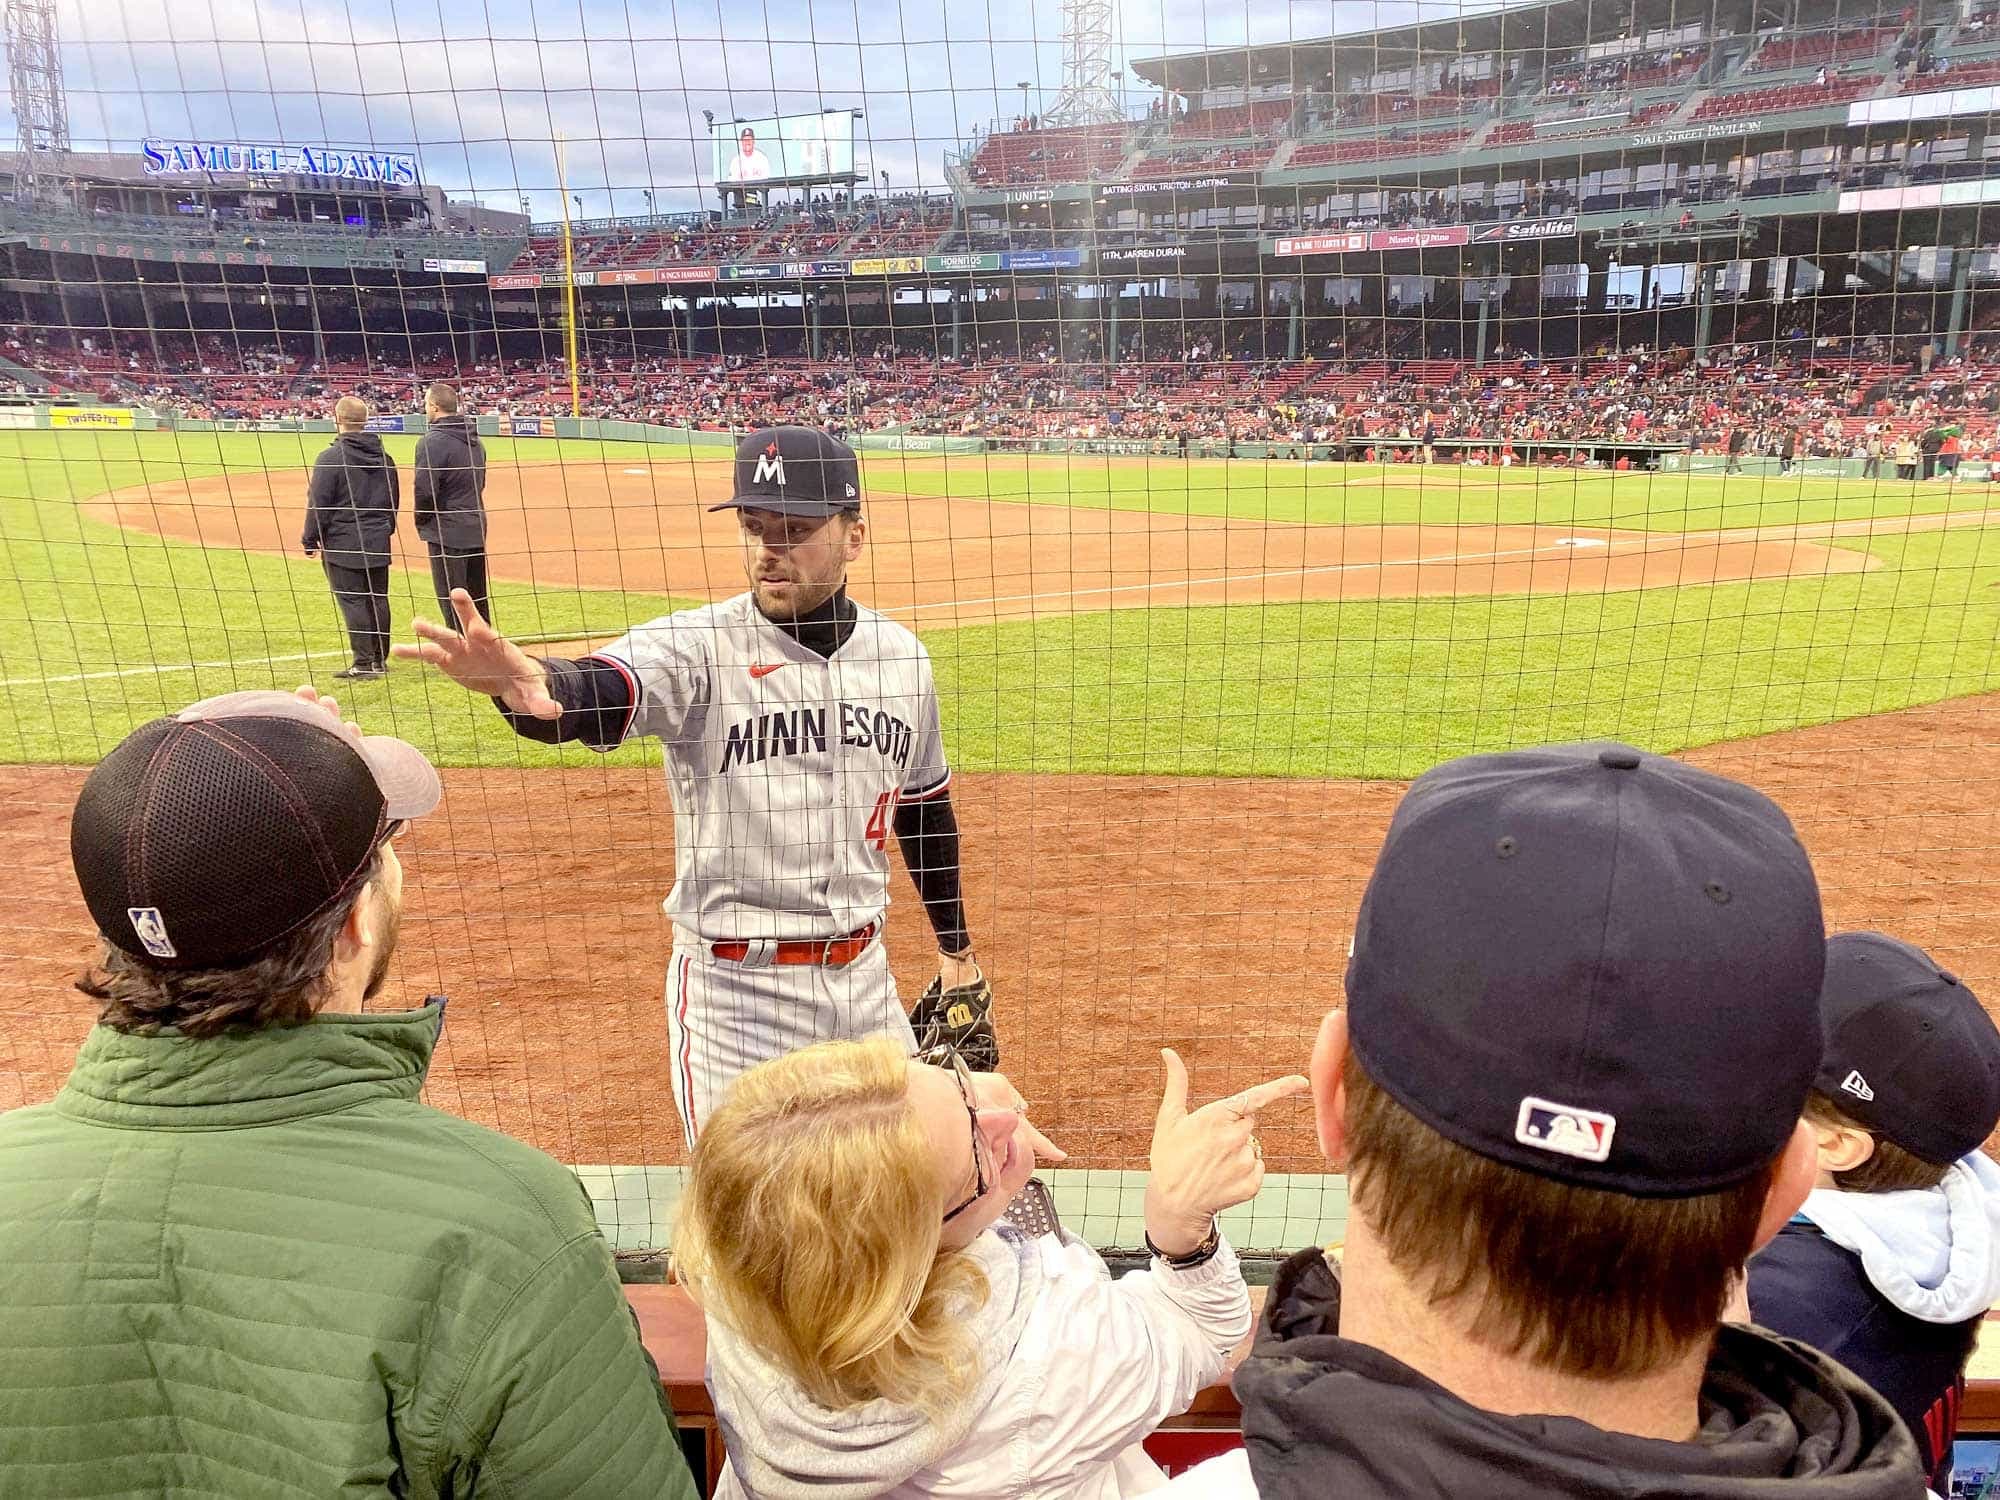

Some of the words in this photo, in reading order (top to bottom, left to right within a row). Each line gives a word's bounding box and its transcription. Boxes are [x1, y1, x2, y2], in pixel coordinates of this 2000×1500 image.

[1632, 133, 1663, 146] STATE
[1665, 127, 1705, 142] STREET
[142, 137, 290, 175] SAMUEL
[294, 144, 416, 186] ADAMS
[1102, 185, 1133, 196] BATTING
[1508, 221, 1574, 238] Safelite
[940, 255, 982, 267] HORNITOS
[719, 702, 912, 773] MINNESOTA
